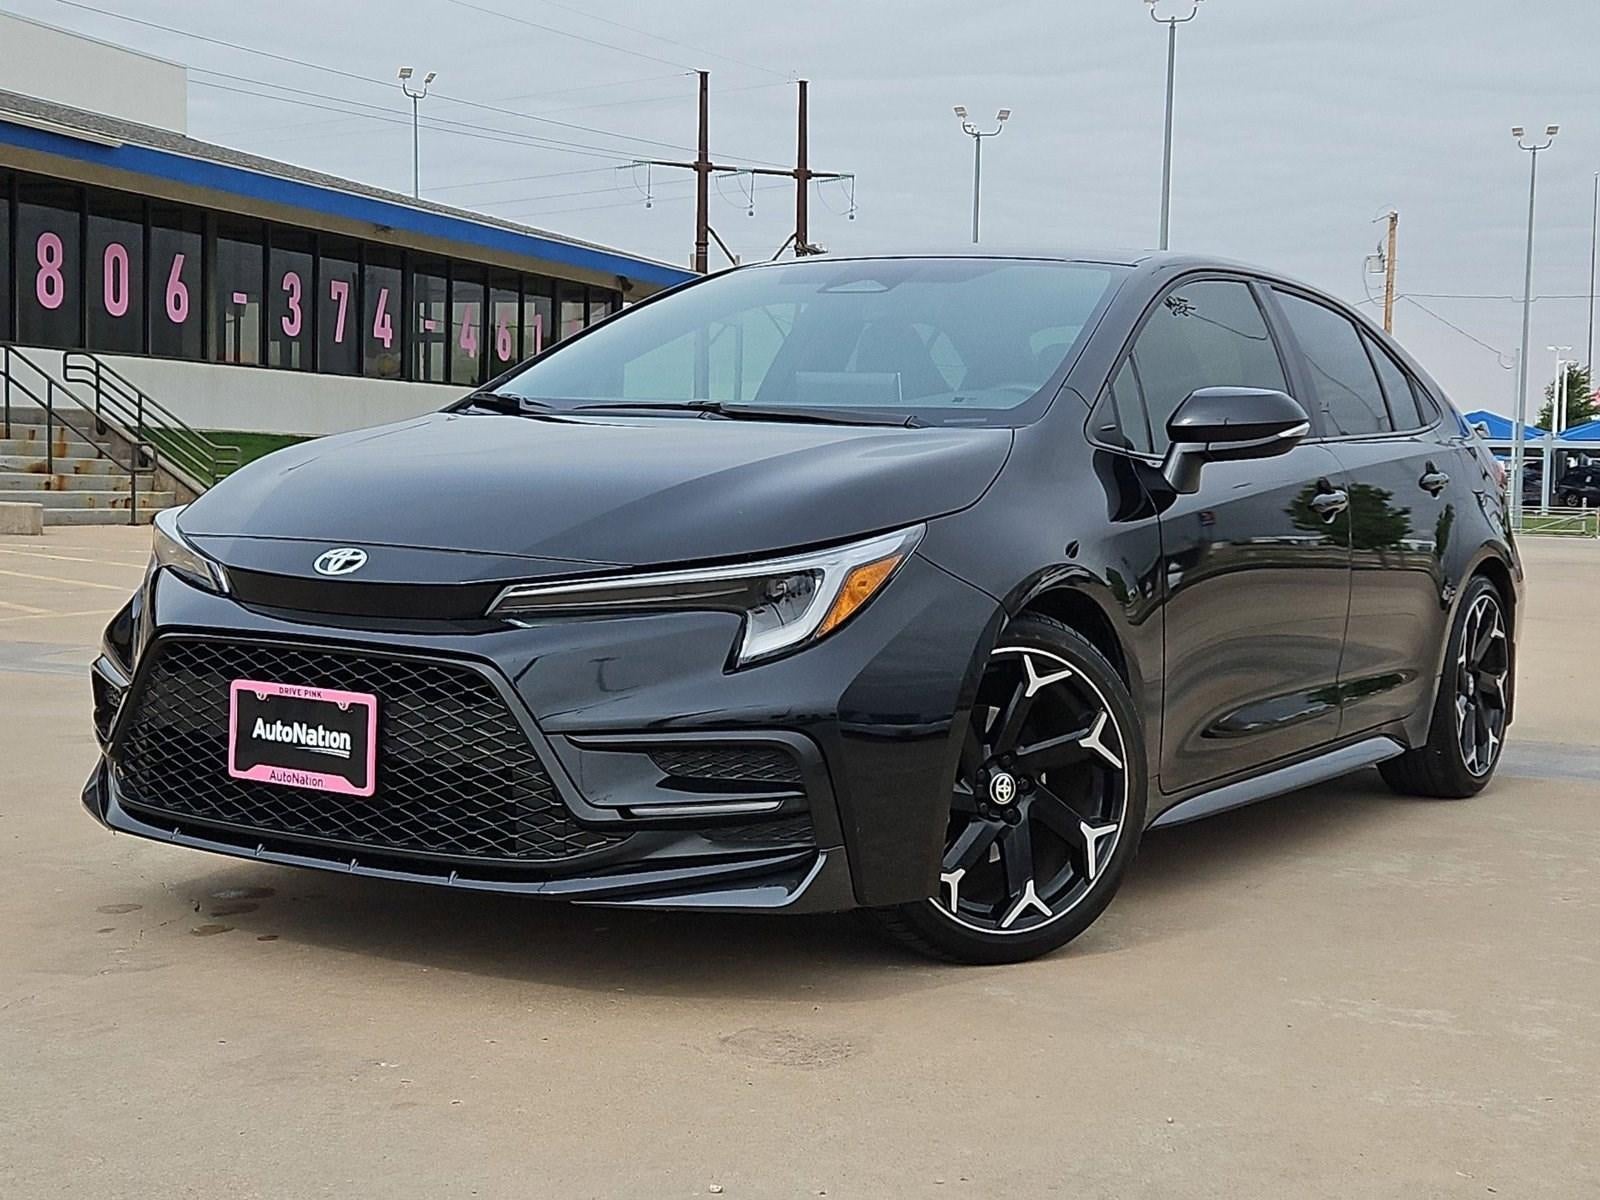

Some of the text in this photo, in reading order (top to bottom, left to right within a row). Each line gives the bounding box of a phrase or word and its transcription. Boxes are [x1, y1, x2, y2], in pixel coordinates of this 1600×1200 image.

[279, 686, 322, 698] DRIVE PINK
[252, 717, 351, 750] AutoNation
[269, 770, 324, 787] AutoNation
